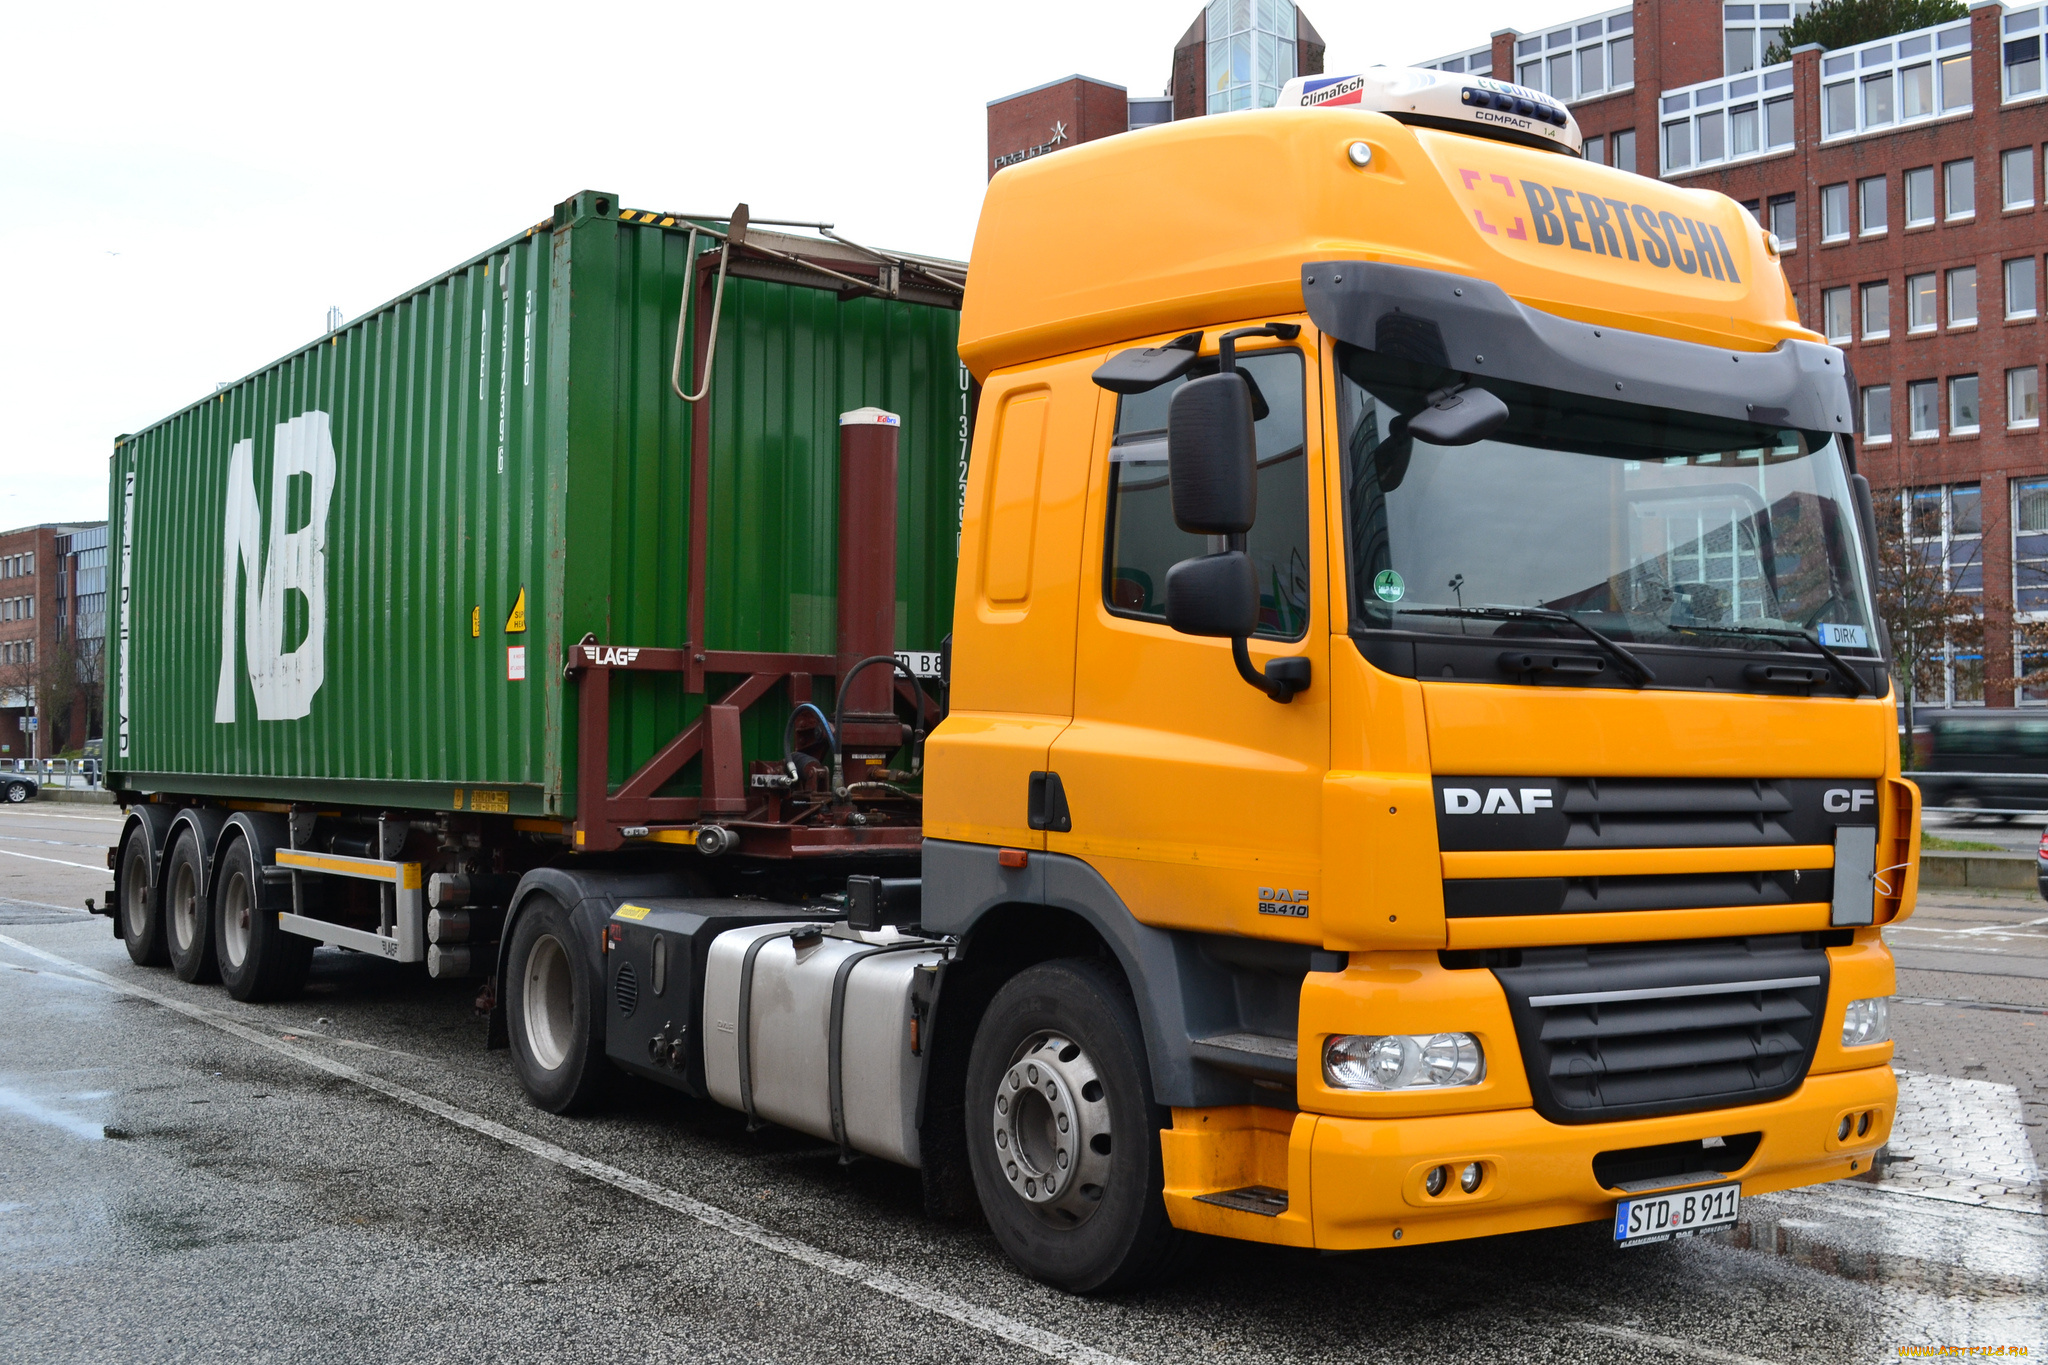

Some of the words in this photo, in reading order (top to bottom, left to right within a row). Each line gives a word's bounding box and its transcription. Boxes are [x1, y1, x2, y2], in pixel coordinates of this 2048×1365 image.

[1300, 77, 1364, 106] ClimaTech
[1475, 111, 1533, 129] COMPACT
[1544, 128, 1556, 137] 1.4
[1519, 179, 1742, 283] BERTSCHI
[214, 409, 337, 724] NB
[1833, 627, 1857, 644] DIRK
[595, 647, 628, 666] LAG
[1443, 788, 1553, 814] DAF
[1823, 789, 1874, 813] CF
[1258, 887, 1309, 902] DAF
[1258, 903, 1307, 916] 85.410
[1629, 1200, 1670, 1233] STD
[1682, 1196, 1696, 1225] B
[1701, 1189, 1736, 1222] 911
